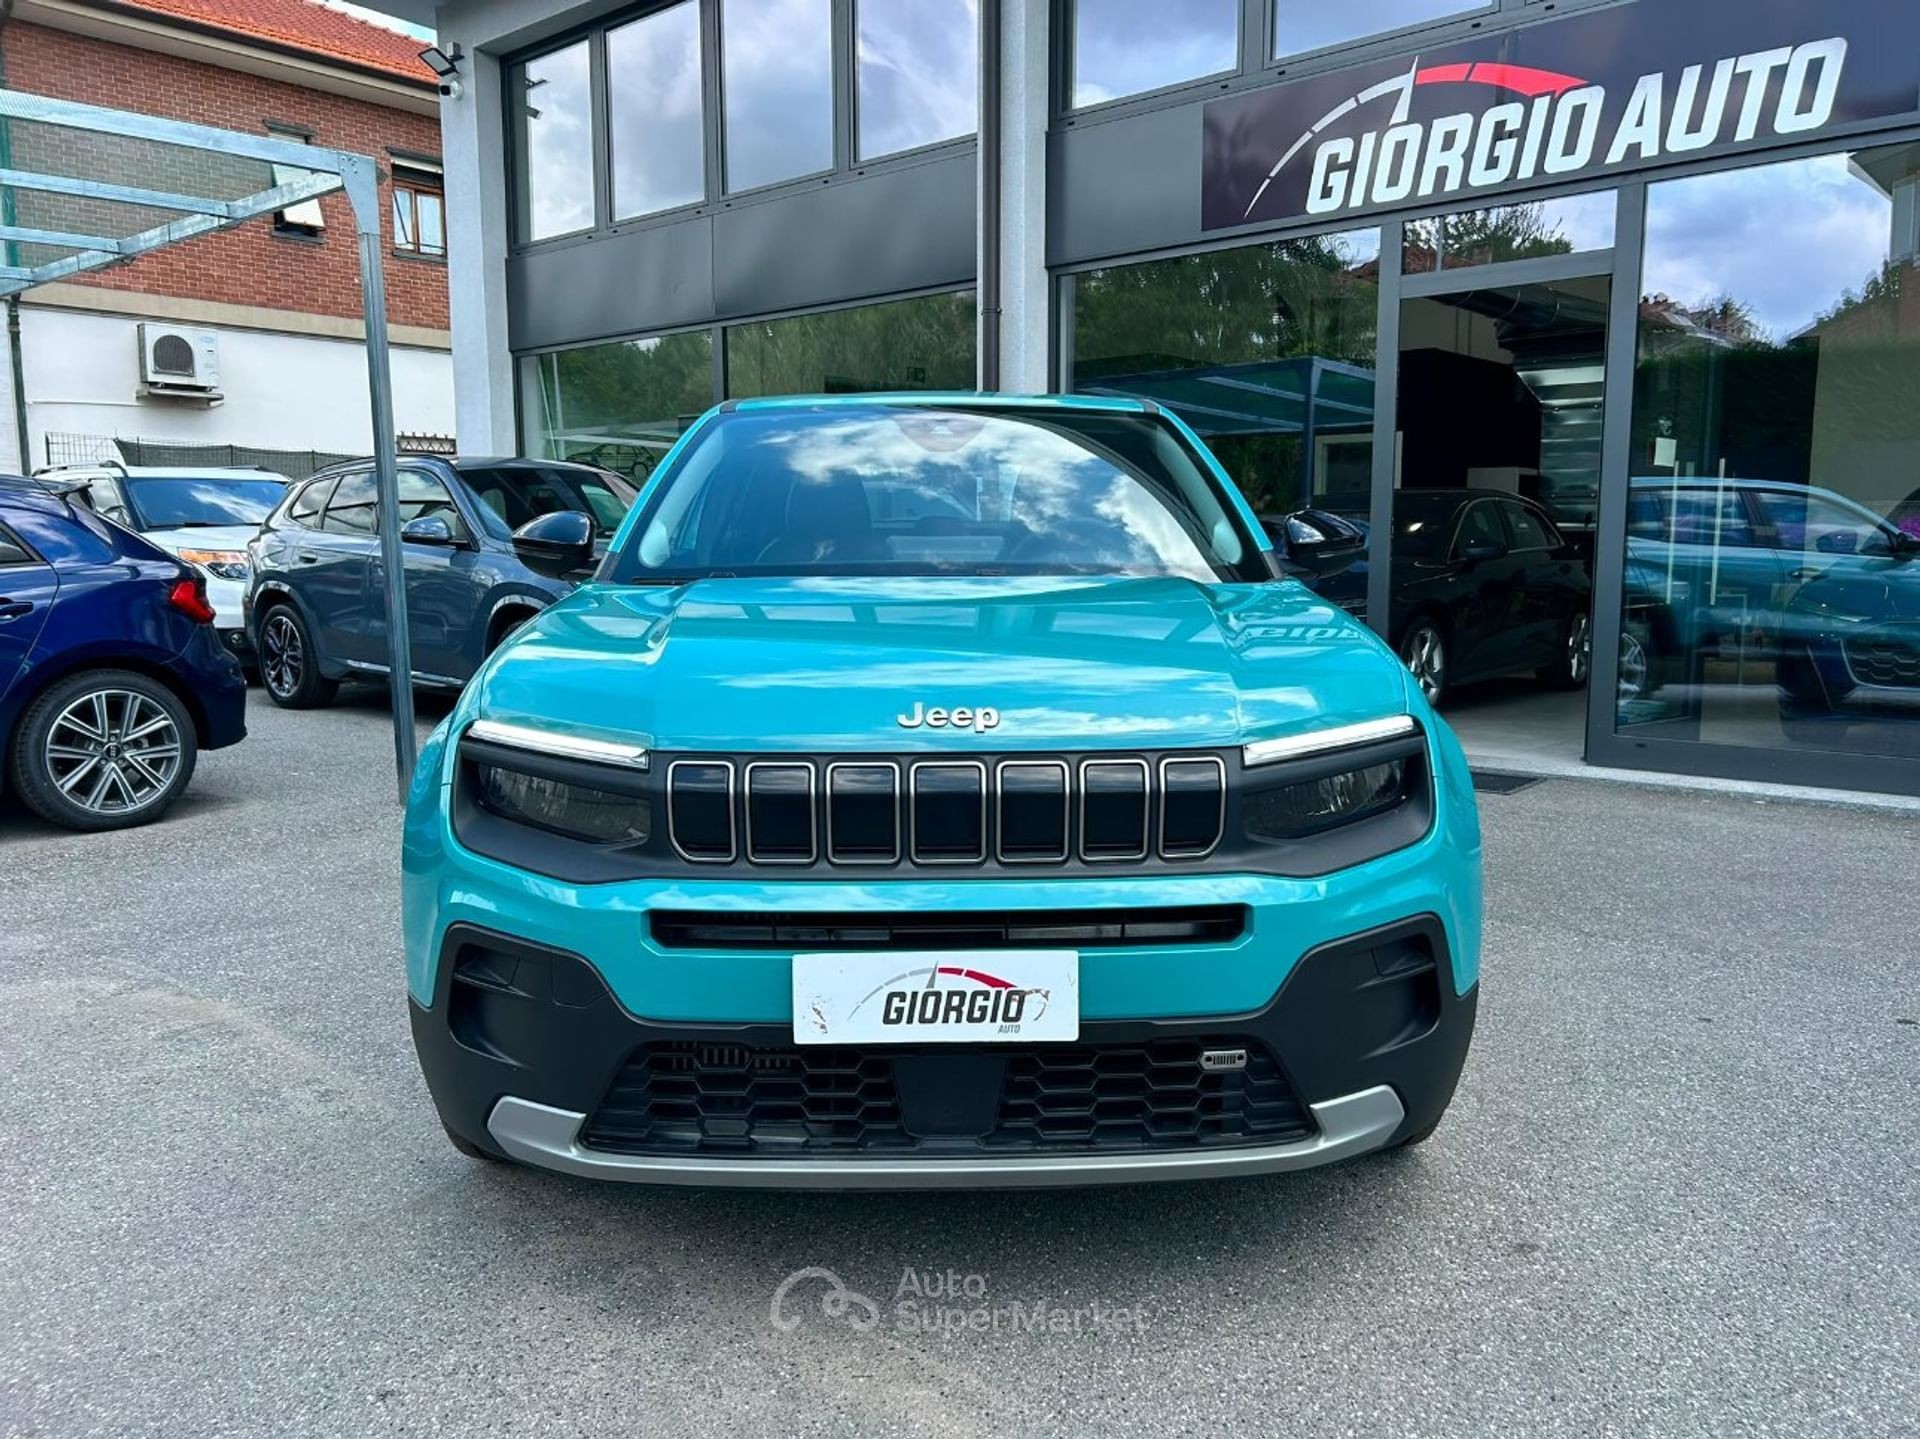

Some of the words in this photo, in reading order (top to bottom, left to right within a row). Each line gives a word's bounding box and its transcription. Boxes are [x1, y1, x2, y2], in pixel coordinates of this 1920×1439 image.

[1305, 85, 1605, 215] GIORGIO
[1605, 37, 1848, 164] AUTO
[897, 702, 1000, 733] Jeep
[882, 989, 1027, 1025] GIORGIO
[998, 1024, 1021, 1034] AUTO
